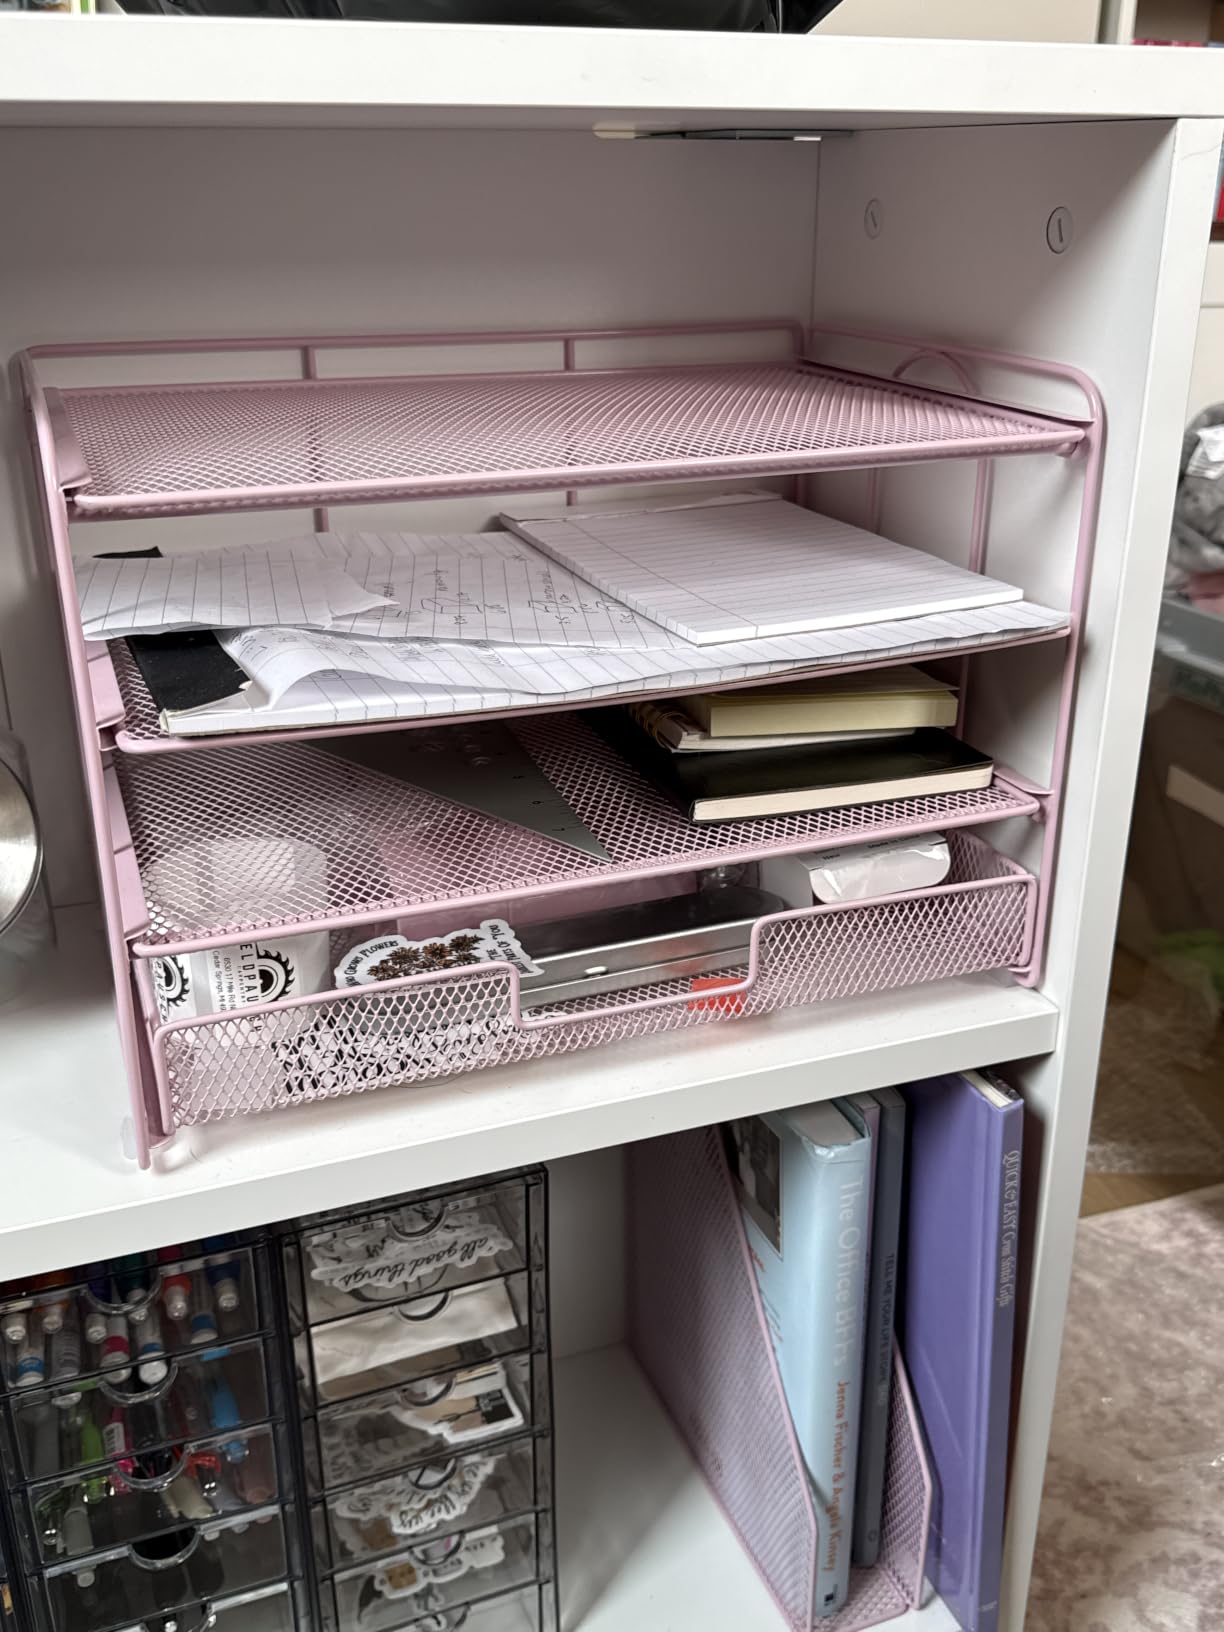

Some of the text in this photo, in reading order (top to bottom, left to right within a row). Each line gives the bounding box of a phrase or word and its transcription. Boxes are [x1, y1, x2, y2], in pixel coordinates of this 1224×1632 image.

[155, 960, 168, 1023] PAUSCH
[1002, 1150, 1020, 1189] QUICK
[840, 1176, 864, 1221] The
[1004, 1189, 1017, 1200] &
[1002, 1201, 1018, 1229] EASY
[339, 1262, 406, 1287] things
[409, 1245, 459, 1273] good
[837, 1227, 861, 1302] Office
[883, 1253, 895, 1279] TELL
[882, 1279, 893, 1296] ME
[880, 1297, 892, 1326] YOUR
[835, 1380, 850, 1419] Jenna
[832, 1421, 848, 1469] Fischer
[831, 1472, 846, 1484] &
[825, 1487, 843, 1528] Angela
[823, 1530, 842, 1572] Kinsey
